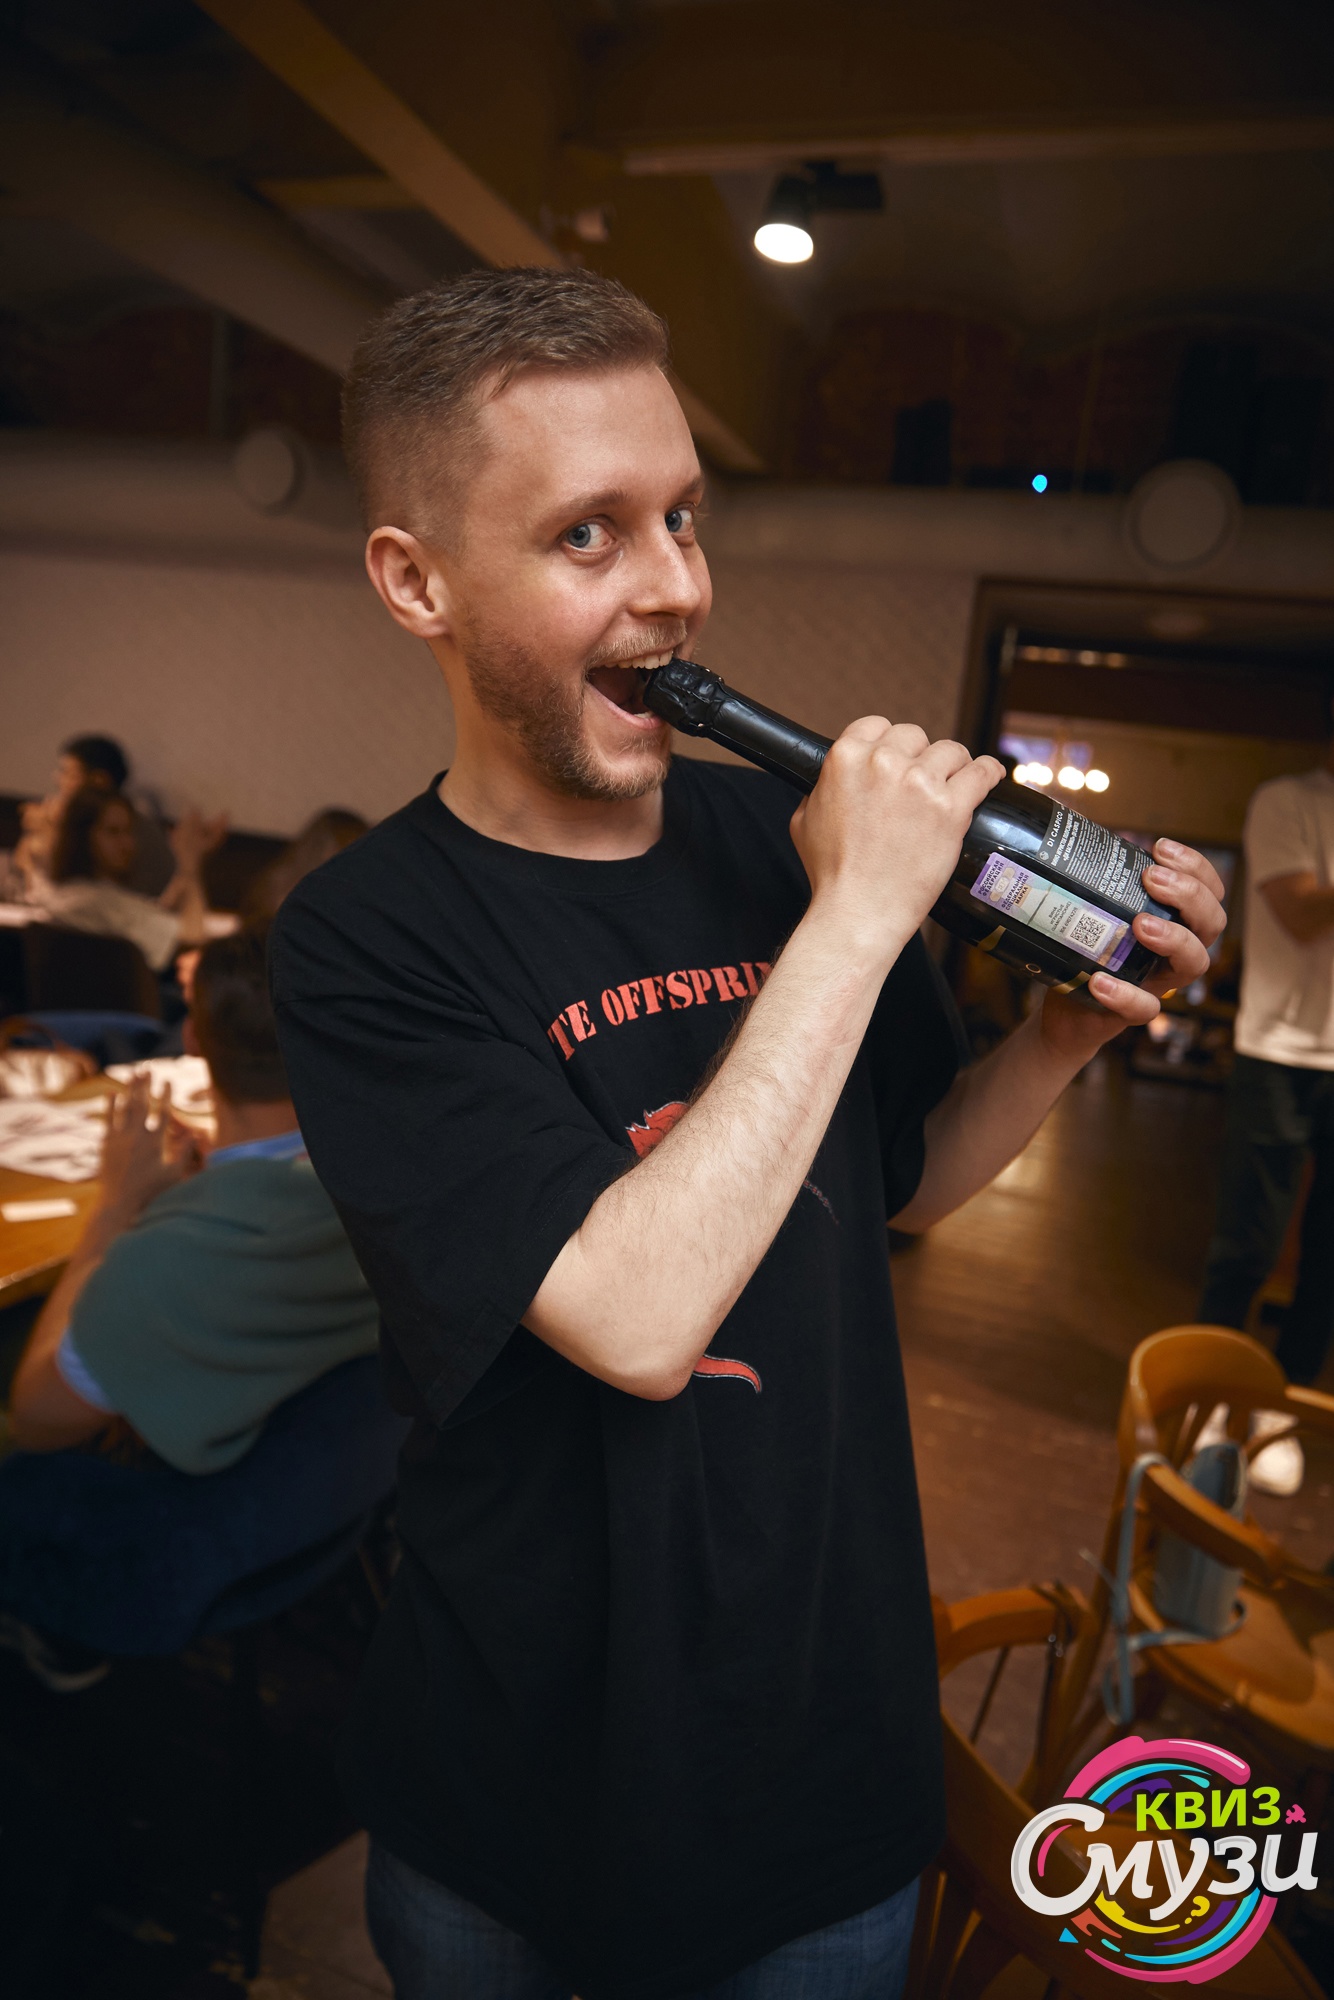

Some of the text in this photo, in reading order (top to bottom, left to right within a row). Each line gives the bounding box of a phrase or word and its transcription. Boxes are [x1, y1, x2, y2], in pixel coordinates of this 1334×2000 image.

[1046, 811, 1063, 847] DI CASPICO
[978, 860, 1000, 894] РОССИЙСКАЯ
[982, 862, 1005, 897] ФЕДЕРАЦИЯ
[1001, 872, 1024, 908] ФЕДЕРАЛЬНАЯ
[1006, 874, 1029, 911] СПЕЦИАЛЬНАЯ
[1015, 886, 1028, 904] МАРКА
[1049, 906, 1057, 918] ВИНА
[1050, 904, 1064, 925] ИГРИСТЫЕ
